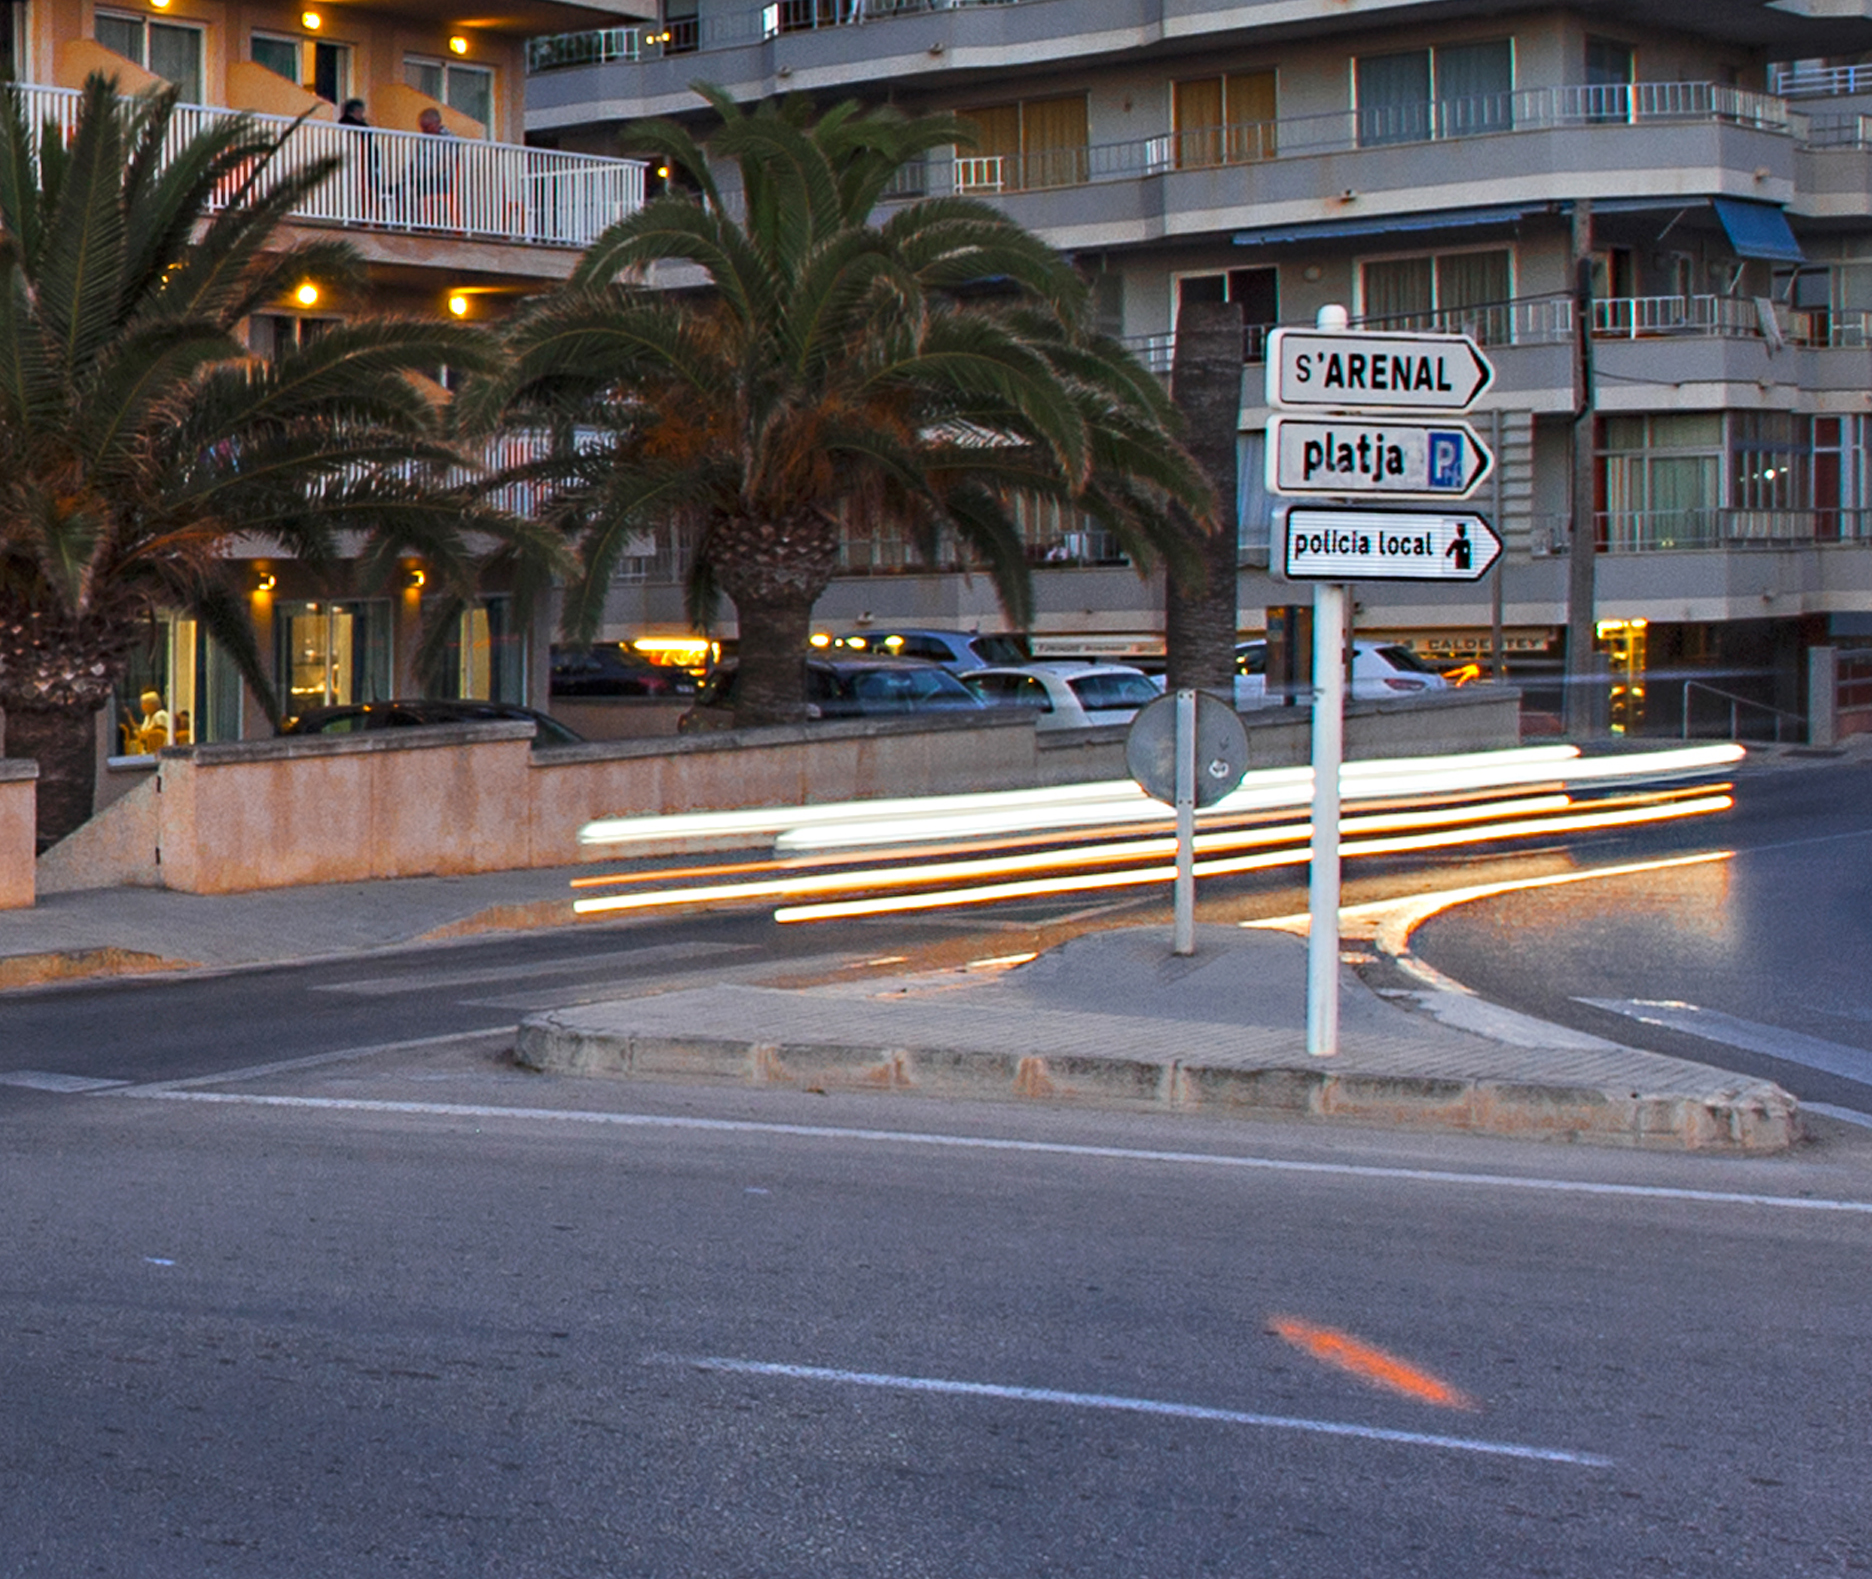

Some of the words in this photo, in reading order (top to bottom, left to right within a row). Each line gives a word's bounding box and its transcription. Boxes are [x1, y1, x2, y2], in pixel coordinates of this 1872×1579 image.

[1295, 352, 1452, 392] S'ARENAL
[1303, 432, 1405, 482] platja
[1435, 440, 1456, 479] P
[1378, 530, 1434, 556] local
[1427, 638, 1538, 651] CALDETEY
